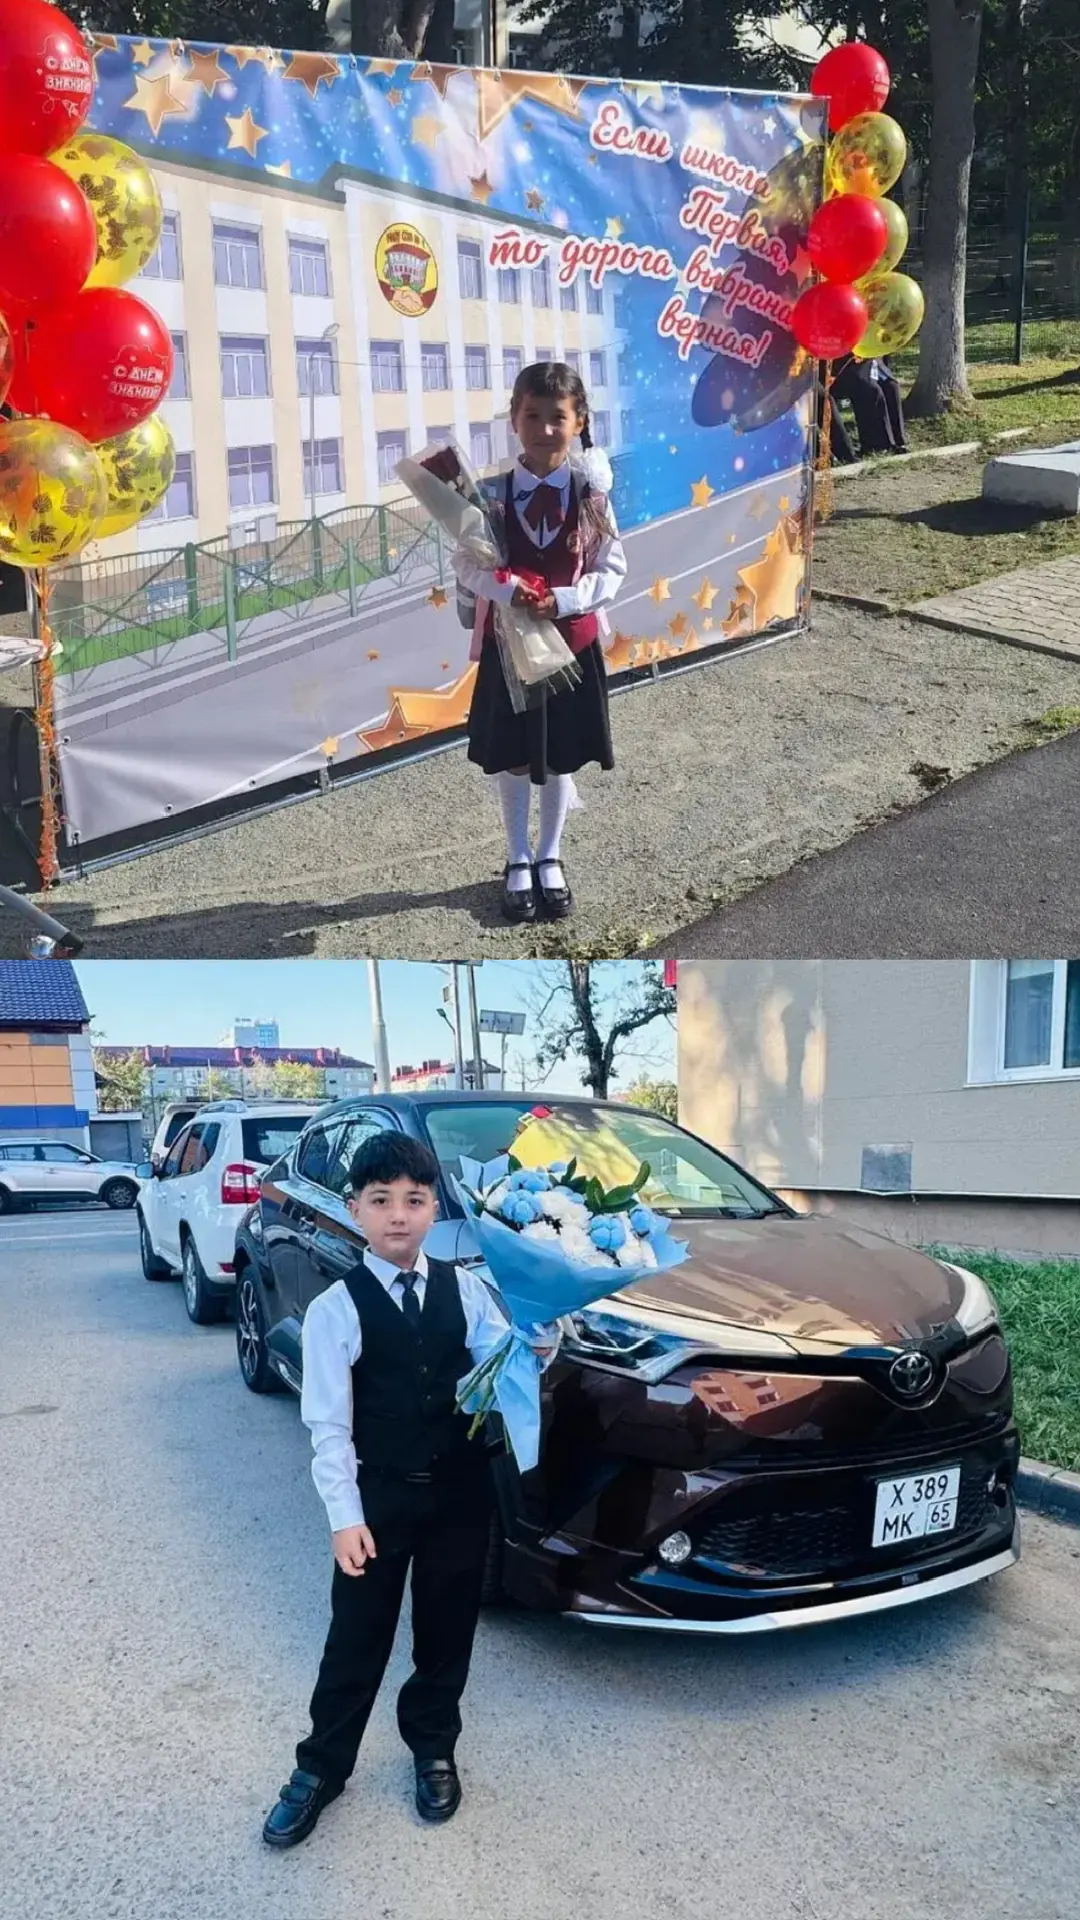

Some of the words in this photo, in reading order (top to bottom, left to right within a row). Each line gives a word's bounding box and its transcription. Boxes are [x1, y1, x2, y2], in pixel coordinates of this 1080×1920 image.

[592, 104, 670, 159] Если
[682, 143, 771, 200] школа
[682, 188, 789, 274] Первая,
[489, 230, 545, 266] то
[558, 236, 672, 285] дорога
[686, 249, 793, 327] выбрана
[658, 298, 771, 367] верная!
[890, 1482, 906, 1508] Х
[912, 1474, 949, 1502] 389
[882, 1512, 914, 1541] МК
[931, 1503, 951, 1523] 65
